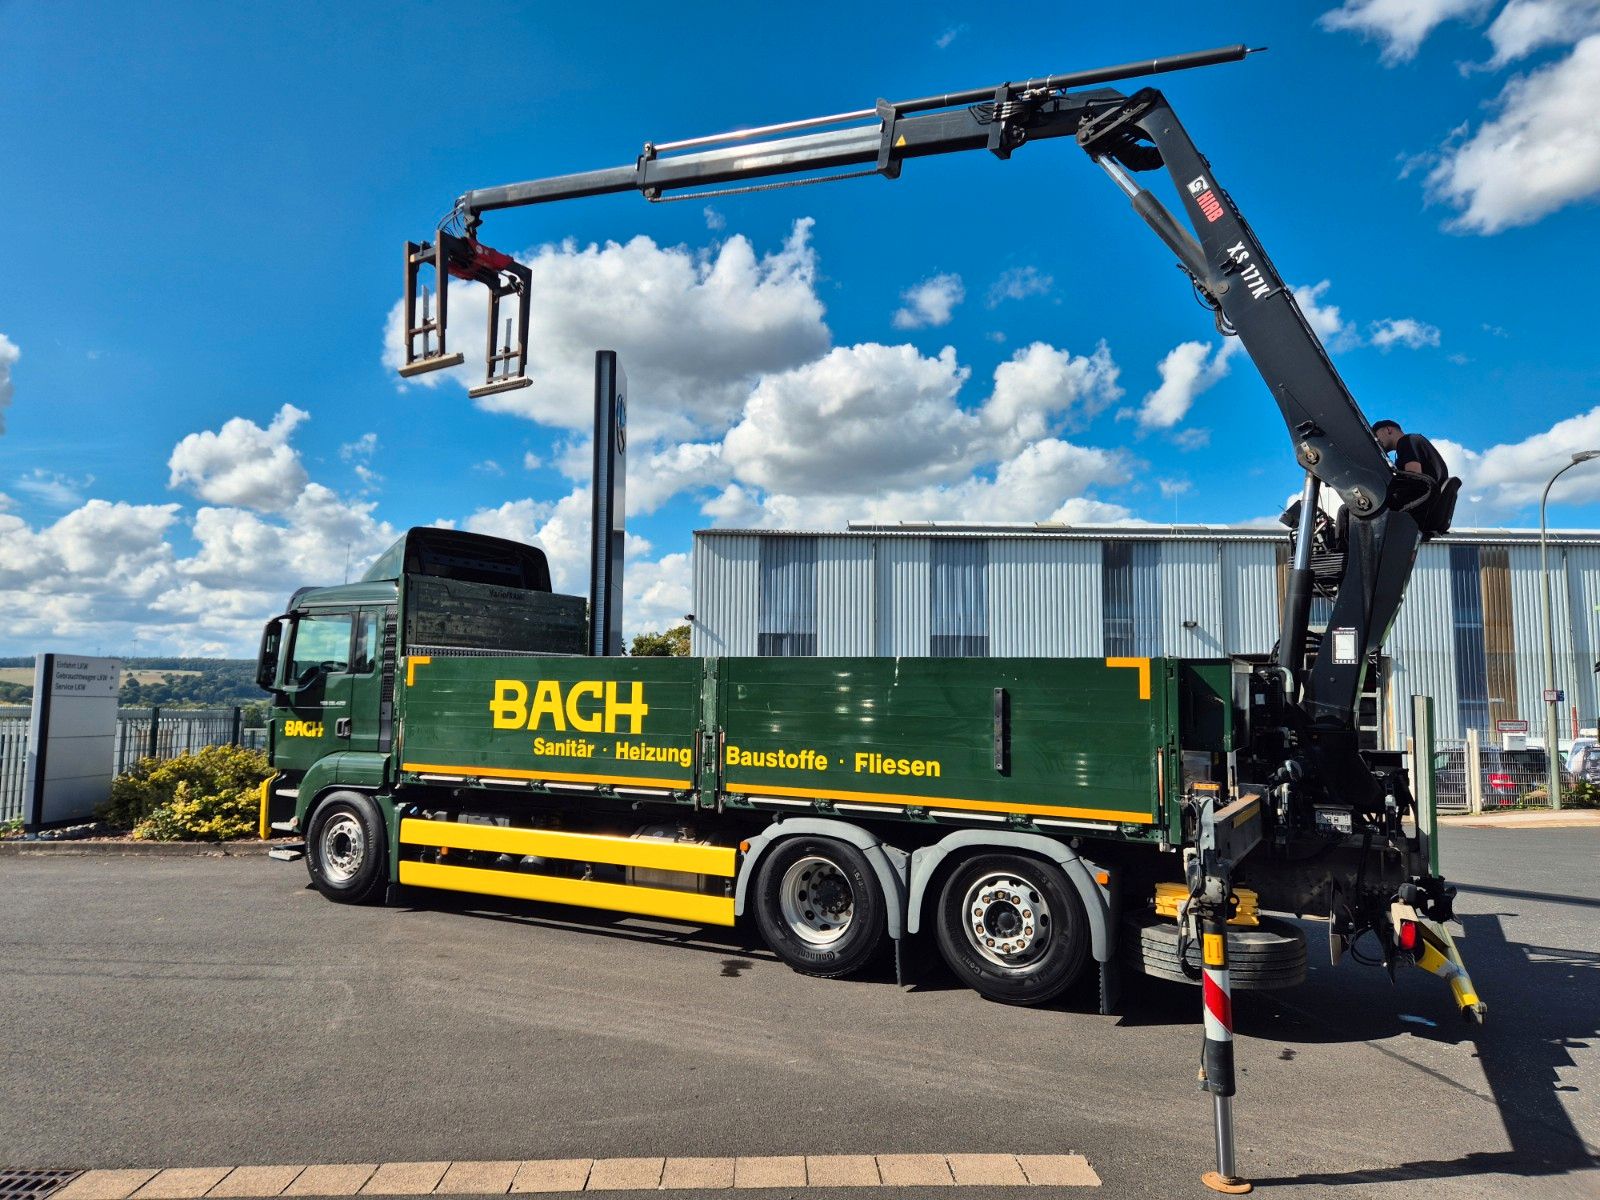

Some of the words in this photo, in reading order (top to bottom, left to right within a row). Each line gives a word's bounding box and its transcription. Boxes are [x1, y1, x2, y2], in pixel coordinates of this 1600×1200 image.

[1196, 190, 1224, 223] HIAB
[1226, 240, 1250, 264] XS
[1240, 263, 1270, 300] 177K
[489, 679, 648, 735] BACH
[284, 720, 324, 738] BACH
[533, 737, 595, 758] Sanitär
[615, 741, 692, 767] Heizung
[726, 745, 828, 771] Baustoffe
[854, 752, 941, 777] Fliesen
